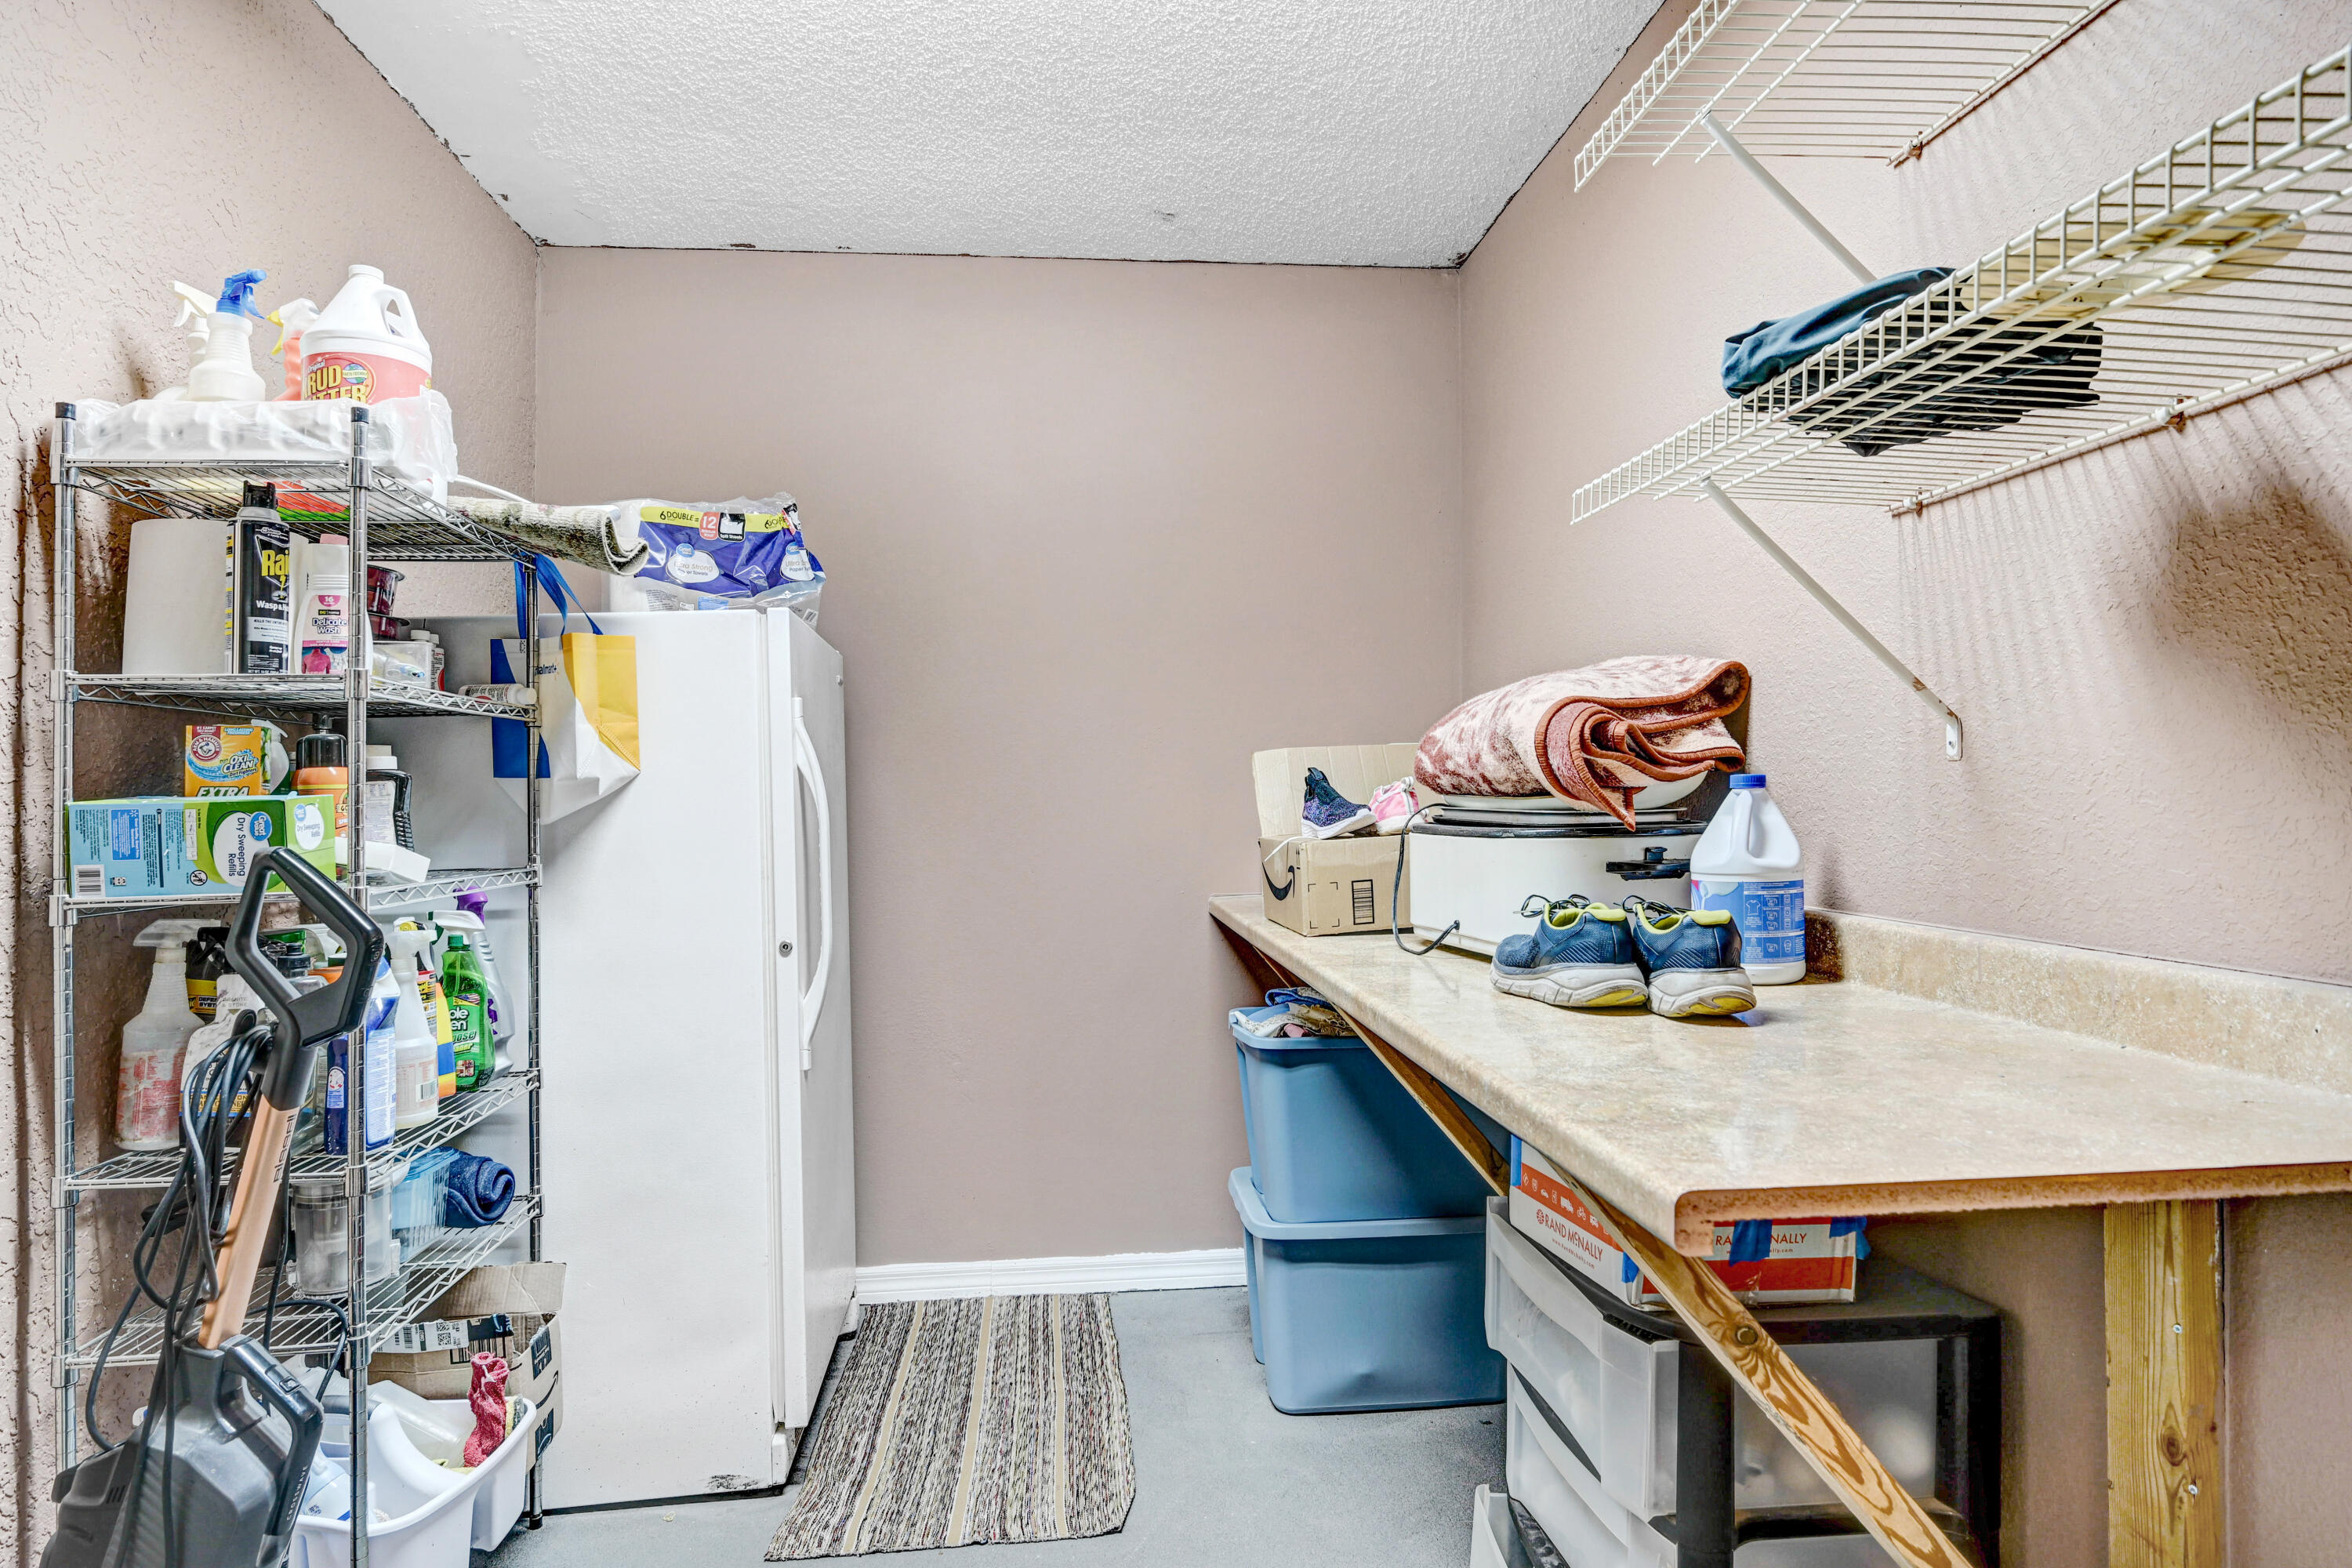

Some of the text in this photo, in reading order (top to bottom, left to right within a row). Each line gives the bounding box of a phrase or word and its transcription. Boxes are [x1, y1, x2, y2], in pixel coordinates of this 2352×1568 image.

[659, 510, 666, 521] 6
[666, 510, 694, 521] DOUBLE
[702, 516, 717, 529] 12
[256, 600, 278, 612] Wasp
[312, 617, 347, 626] Delicate
[230, 754, 249, 764] OXI
[223, 759, 254, 772] CLEAN
[196, 786, 249, 797] EXTRA
[236, 817, 247, 877] Dry Sweeping
[228, 853, 237, 877] Refills
[1545, 1214, 1602, 1261] RAND McNALLY
[1715, 1235, 1732, 1246] RA
[286, 1465, 307, 1520] CROSSWAVE
